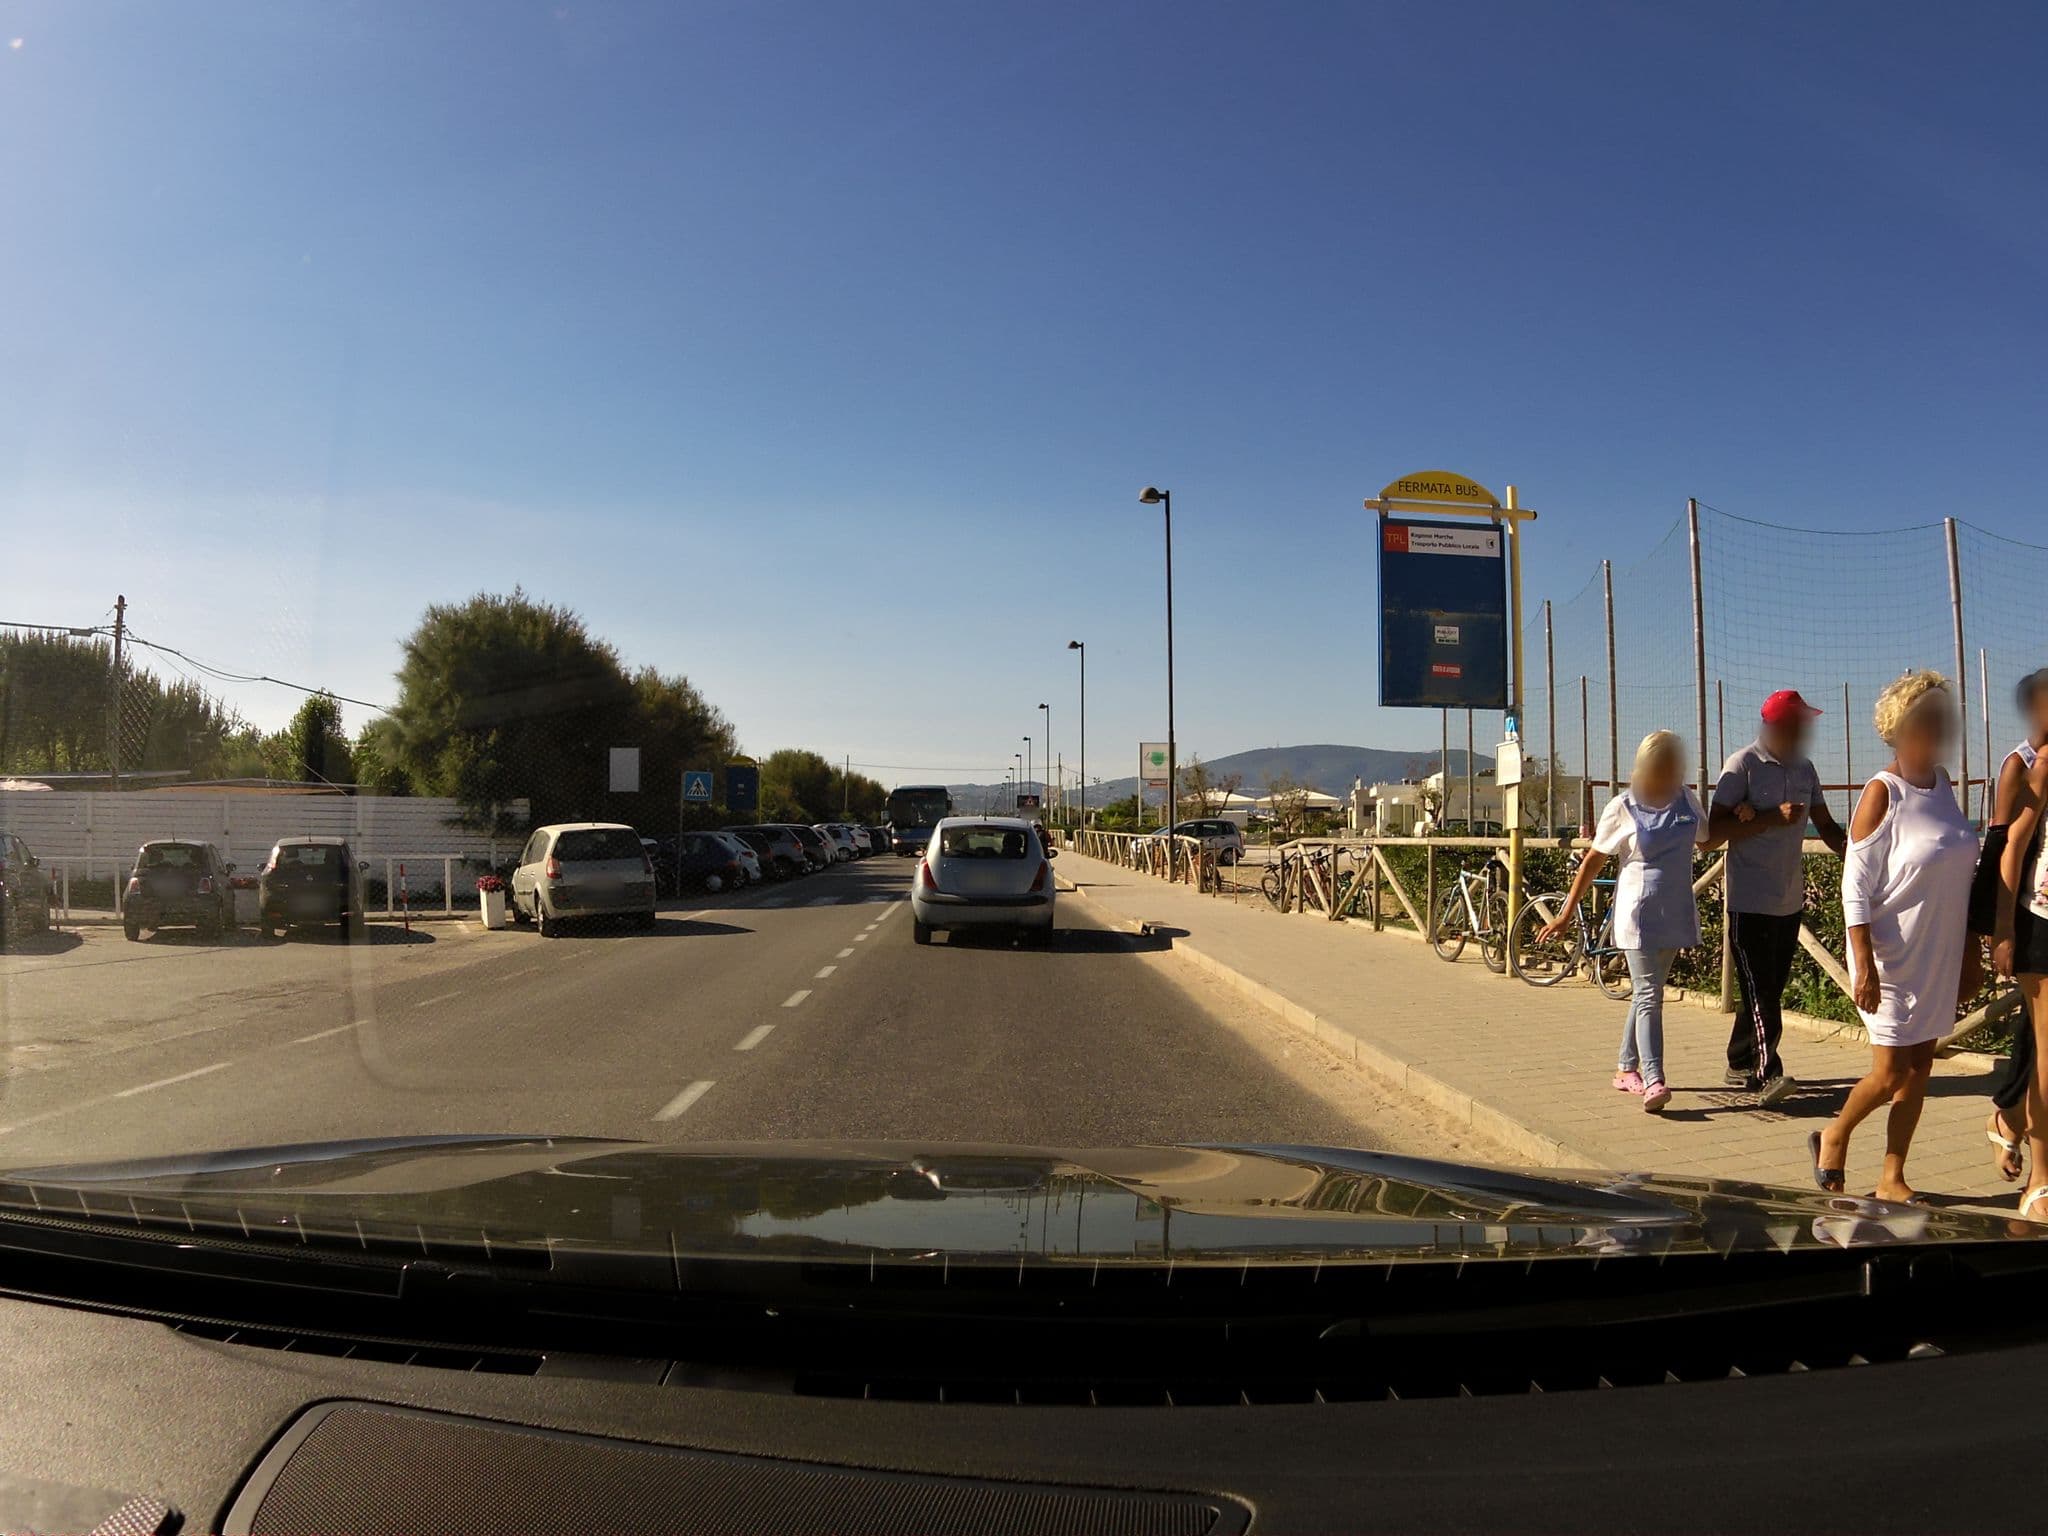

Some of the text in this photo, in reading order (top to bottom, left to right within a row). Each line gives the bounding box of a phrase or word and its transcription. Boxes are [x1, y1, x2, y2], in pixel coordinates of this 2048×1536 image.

[1398, 480, 1479, 497] FERMATA BUS
[1384, 533, 1406, 544] TPL
[1411, 540, 1438, 548] Trasporto
[1438, 542, 1462, 550] Pubblico
